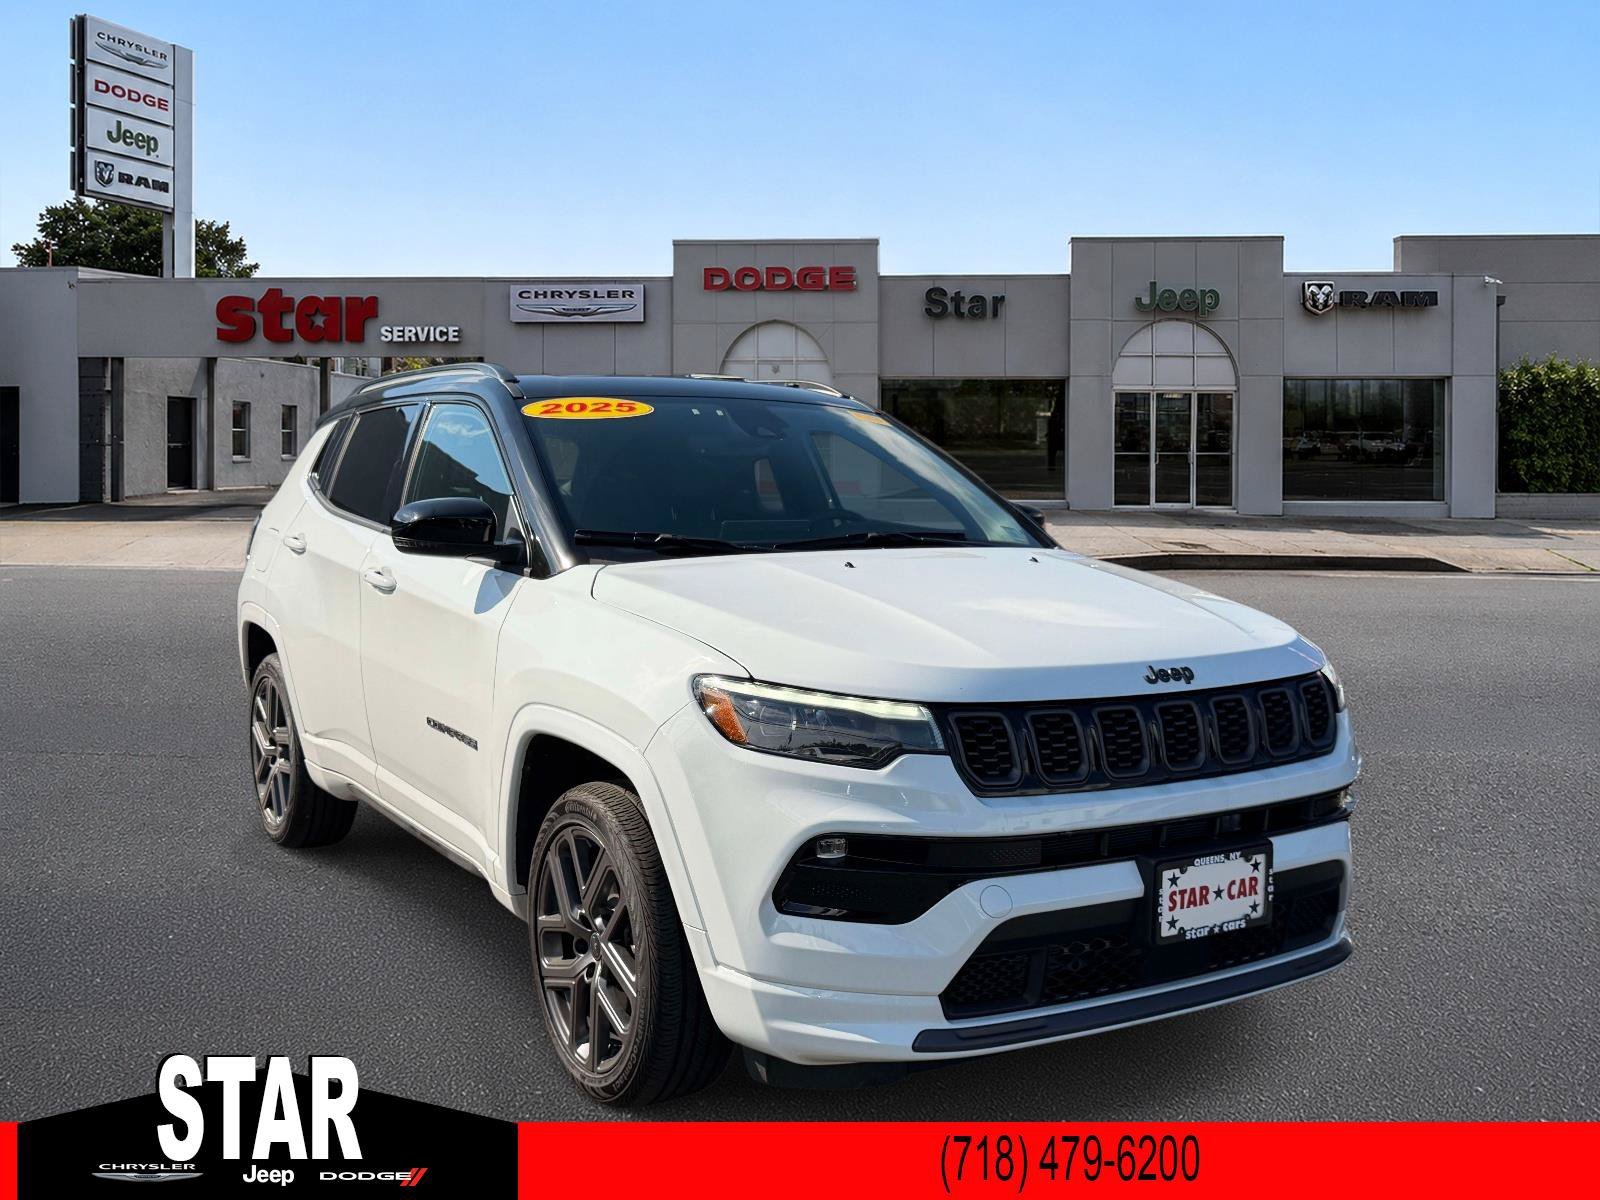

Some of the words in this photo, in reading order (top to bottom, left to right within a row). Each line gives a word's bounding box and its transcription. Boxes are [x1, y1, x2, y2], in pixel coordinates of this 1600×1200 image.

[97, 31, 167, 60] CHRYSLER
[94, 79, 168, 111] DODGE
[107, 120, 159, 156] Jeep
[118, 171, 169, 193] RAM
[703, 266, 857, 293] DODGE
[518, 288, 636, 300] CHRYSLER
[925, 287, 1006, 319] Star
[1134, 281, 1220, 317] Jeep
[1339, 290, 1438, 308] RAM
[216, 287, 379, 344] star
[380, 325, 461, 343] SERVICE
[539, 402, 637, 414] 2025
[1144, 665, 1194, 684] Jeep
[1229, 851, 1241, 861] NY
[1168, 885, 1210, 912] STAR
[1227, 876, 1259, 901] CAR
[1185, 926, 1211, 940] star
[1222, 918, 1247, 932] cars
